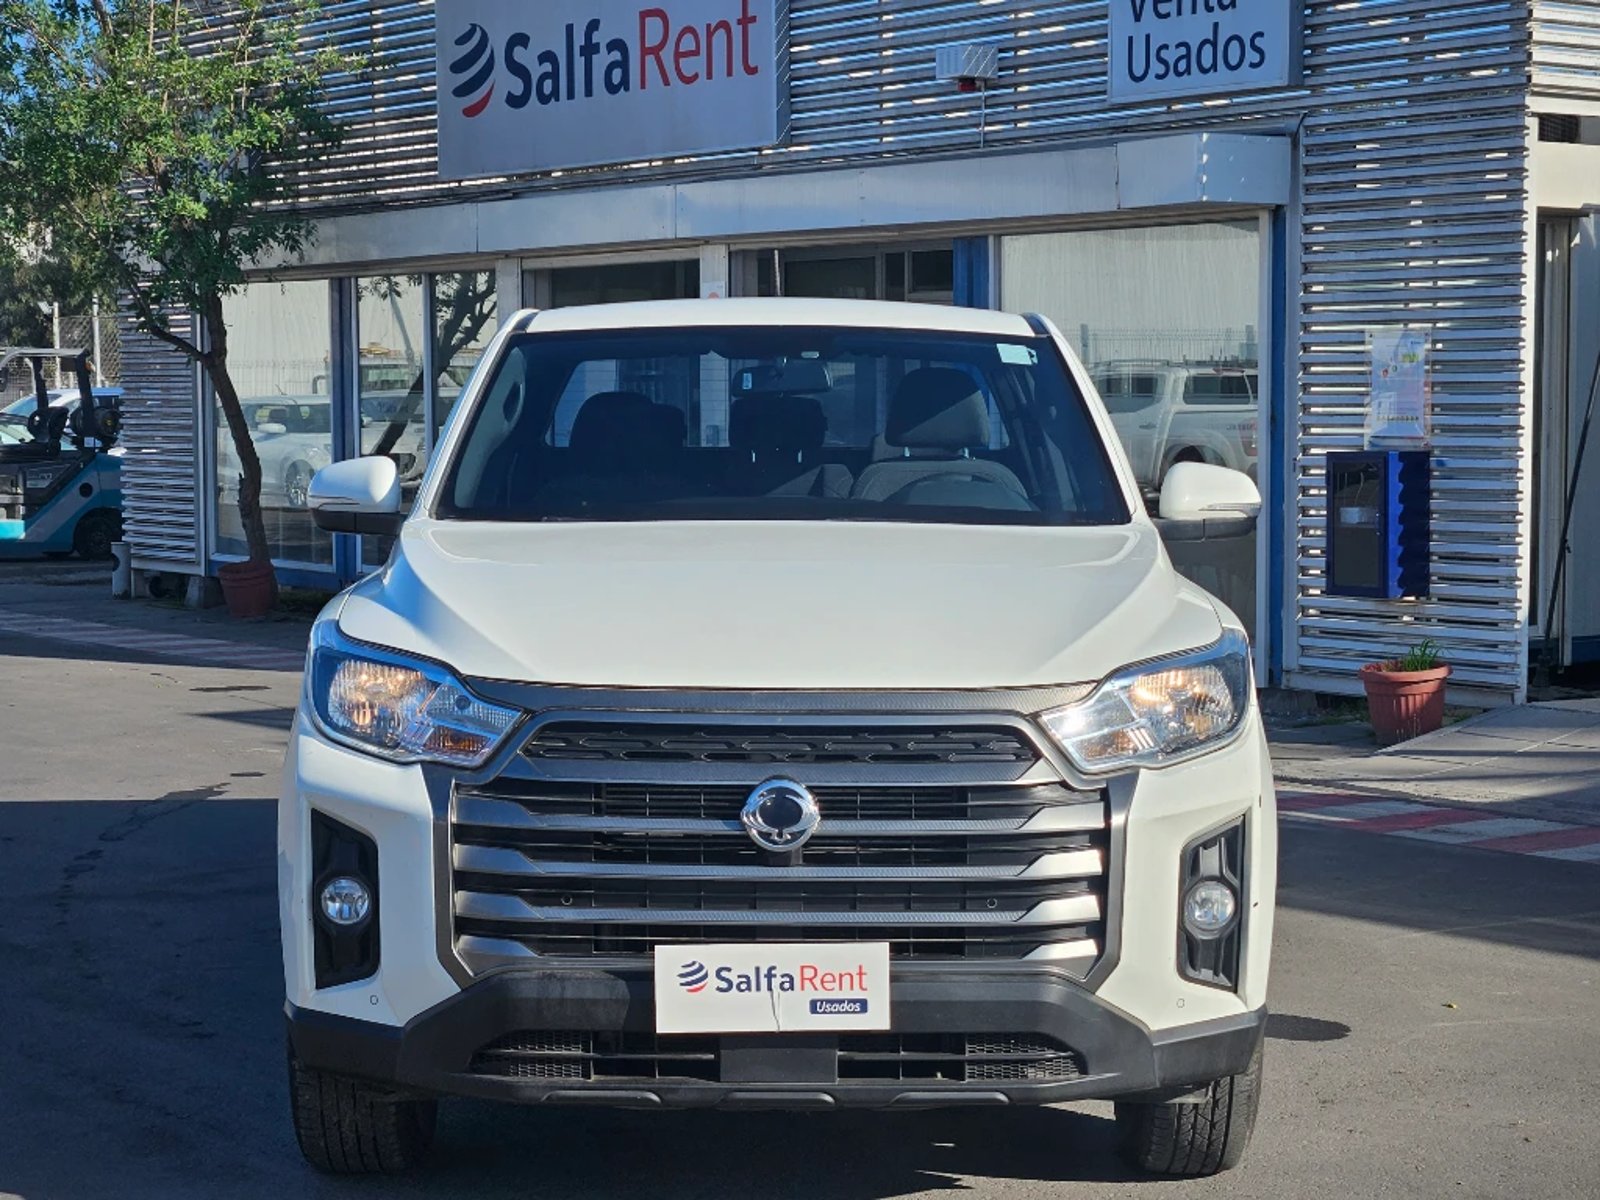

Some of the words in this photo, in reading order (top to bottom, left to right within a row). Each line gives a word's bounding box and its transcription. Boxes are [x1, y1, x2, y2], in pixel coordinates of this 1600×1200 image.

[504, 0, 759, 110] SalfaRent
[1127, 22, 1266, 84] Usados
[714, 964, 868, 994] SalfaRent
[816, 1000, 862, 1013] Usados
